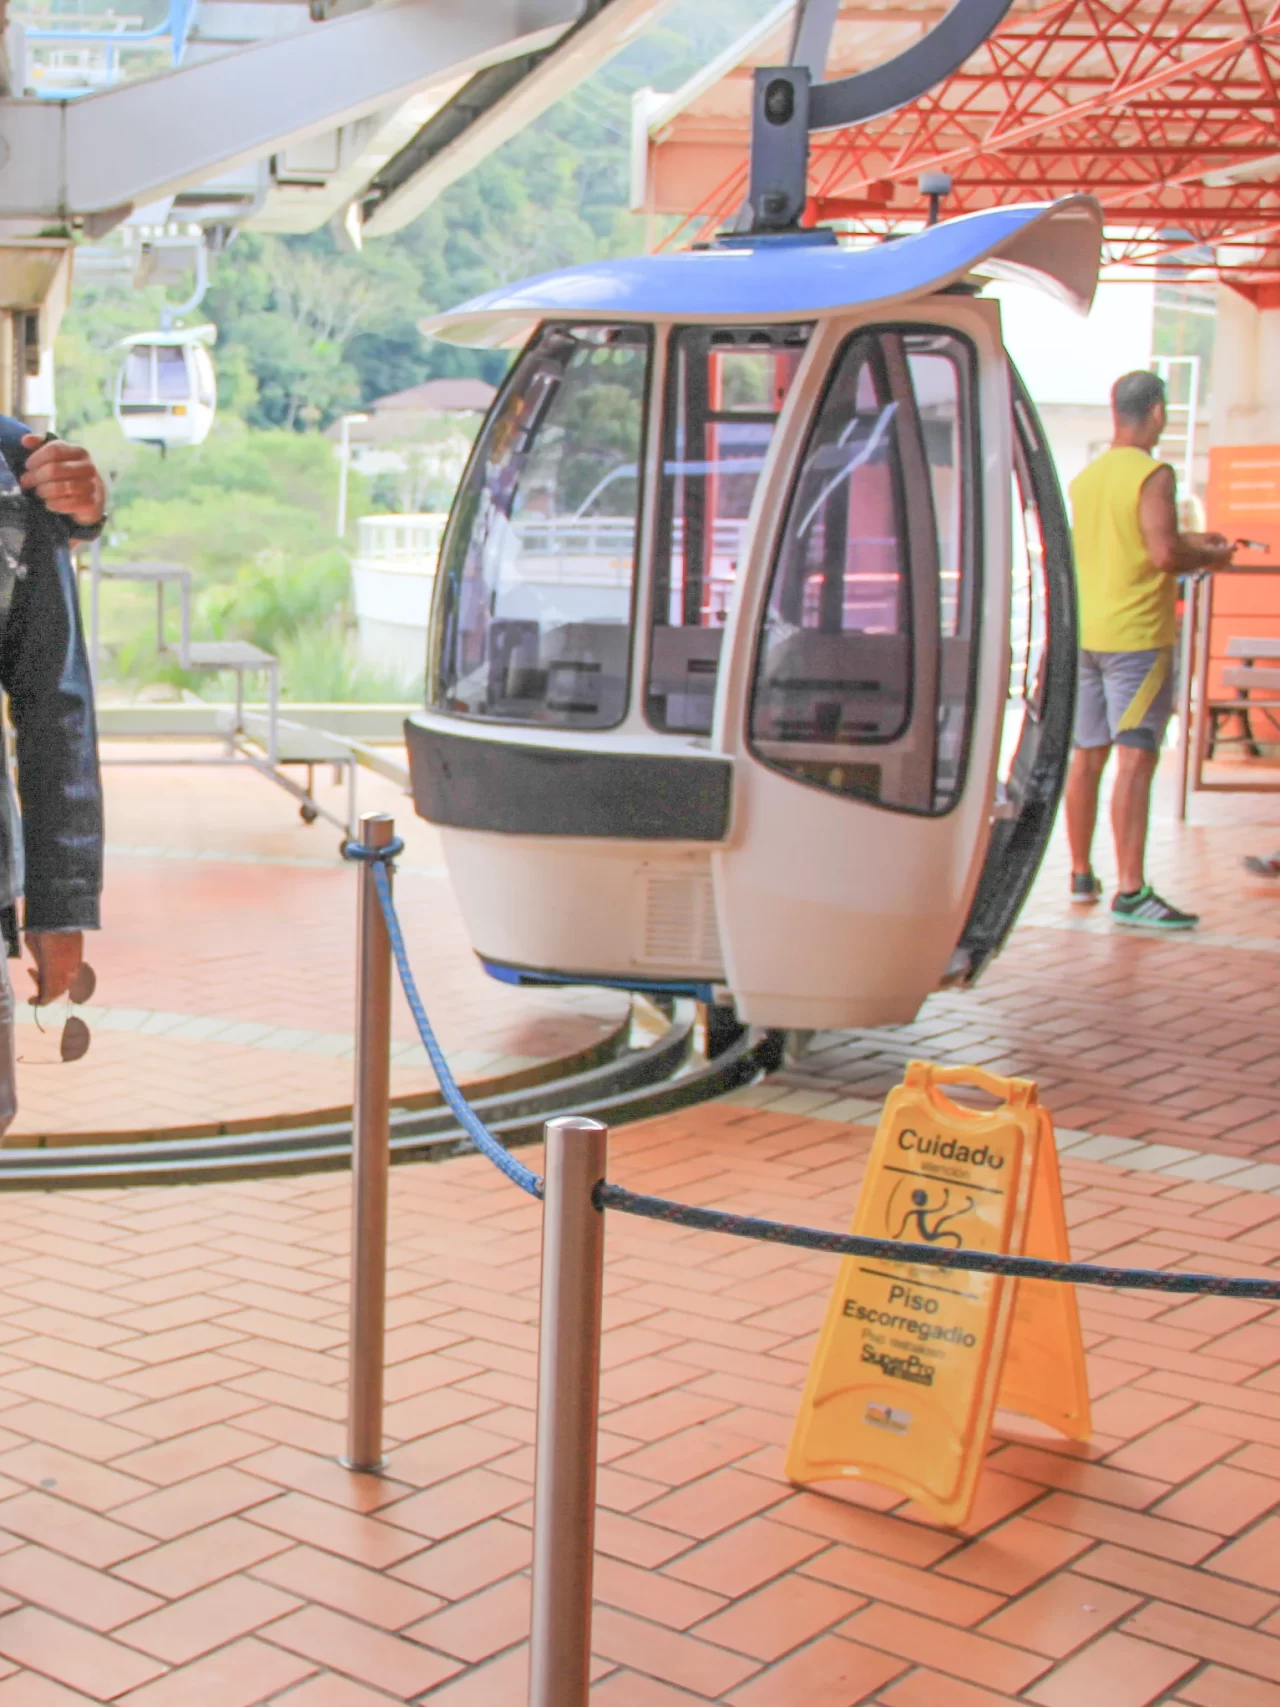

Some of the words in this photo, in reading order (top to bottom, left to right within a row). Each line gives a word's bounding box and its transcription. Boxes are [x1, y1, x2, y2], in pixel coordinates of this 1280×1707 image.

[898, 1128, 1004, 1168] Cuidado
[888, 1284, 939, 1314] Piso
[842, 1299, 976, 1348] Escorregadio
